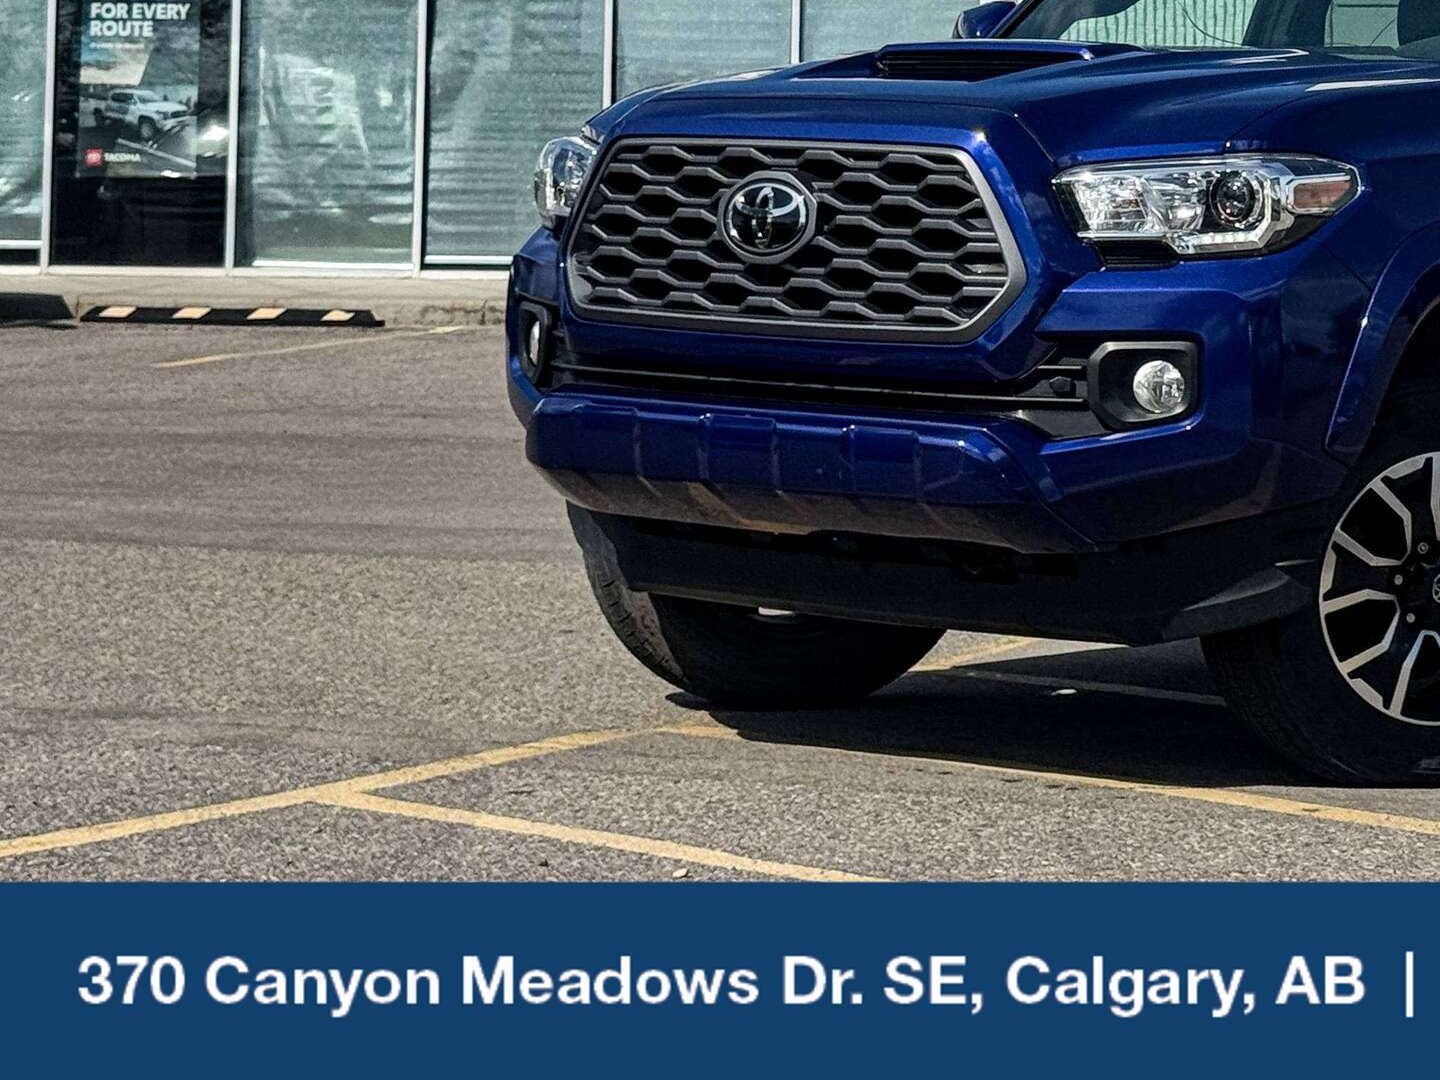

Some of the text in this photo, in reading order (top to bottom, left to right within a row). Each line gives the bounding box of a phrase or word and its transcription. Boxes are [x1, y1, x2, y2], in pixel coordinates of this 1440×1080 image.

[90, 2, 191, 20] FOR EVERY
[90, 20, 154, 37] ROUTE
[104, 152, 141, 162] TACOMA
